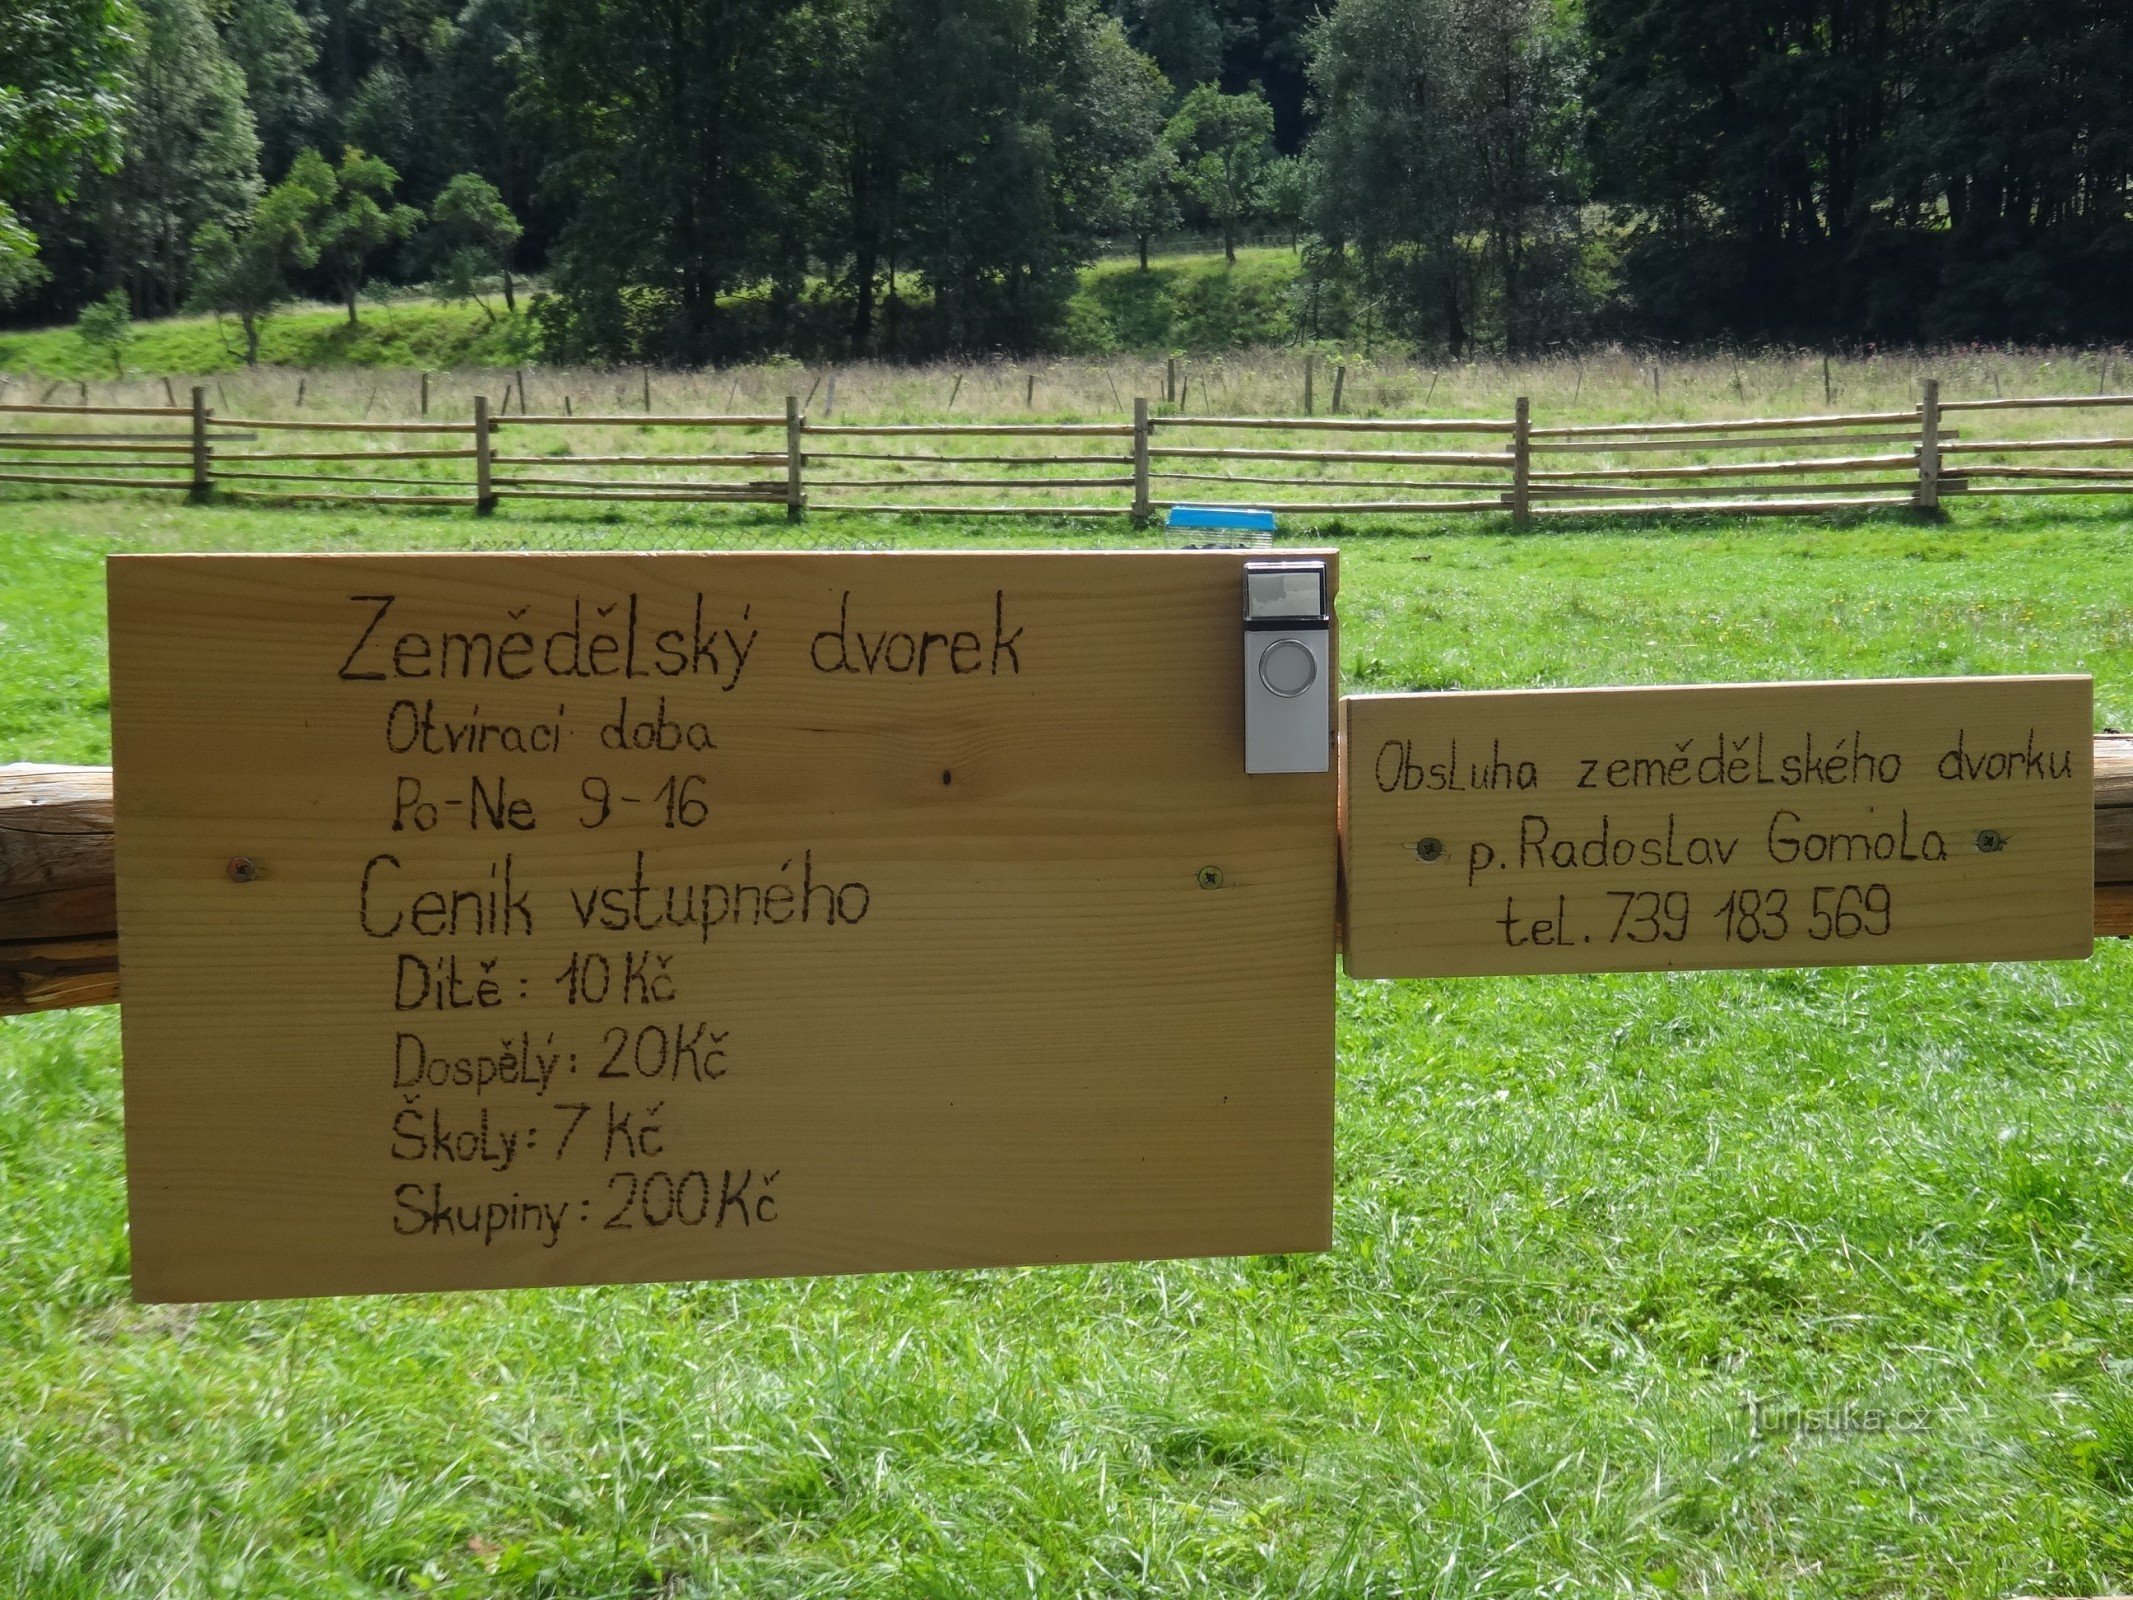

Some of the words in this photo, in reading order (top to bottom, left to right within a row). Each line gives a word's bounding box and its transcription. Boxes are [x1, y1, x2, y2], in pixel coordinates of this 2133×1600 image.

[338, 592, 758, 692] Zemědělský
[810, 588, 1025, 676] dvorek
[600, 696, 717, 752] doba
[1375, 737, 1538, 793] Obsluha
[1577, 730, 1902, 790] zemědělského
[1937, 728, 2072, 781] dvorku
[390, 774, 538, 832] Po-Ne
[359, 852, 534, 938] Ceník
[571, 848, 870, 944] vstupného
[1496, 895, 1592, 947] tel.
[1606, 890, 1690, 944] 739
[1714, 888, 1789, 942] 183
[1807, 883, 1892, 942] 569
[394, 952, 528, 1012] Dítě:
[394, 1030, 578, 1096] Dospělý:
[391, 1094, 538, 1172] Školy:
[554, 1103, 592, 1160] 7
[393, 1182, 590, 1248] Skupiny:
